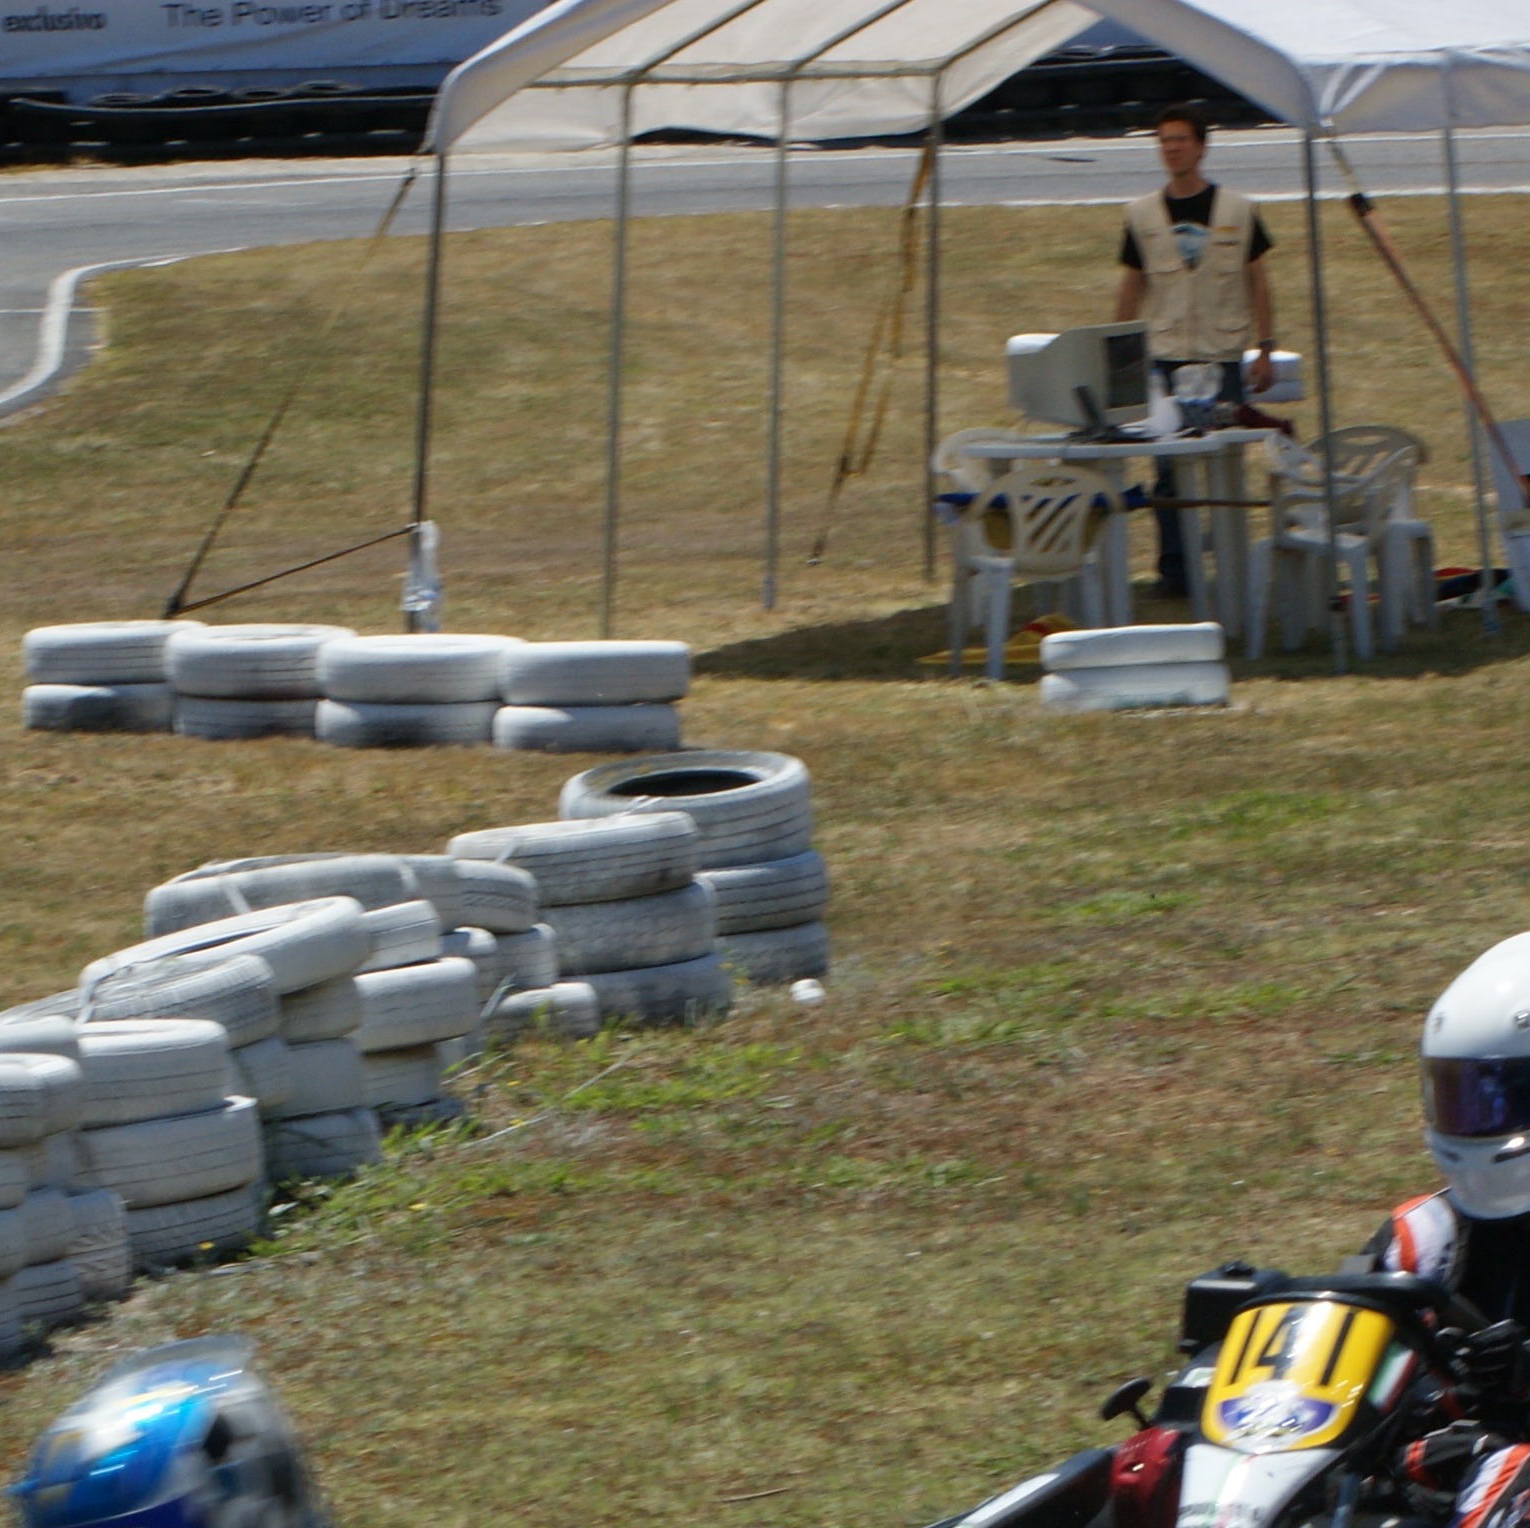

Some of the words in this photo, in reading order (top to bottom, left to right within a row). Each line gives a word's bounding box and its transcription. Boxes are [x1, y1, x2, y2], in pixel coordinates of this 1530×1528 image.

[4, 7, 107, 33] exclusivo
[166, 2, 221, 28] The
[231, 2, 333, 27] Power
[340, 0, 373, 22] of
[377, 0, 501, 20] Dreams
